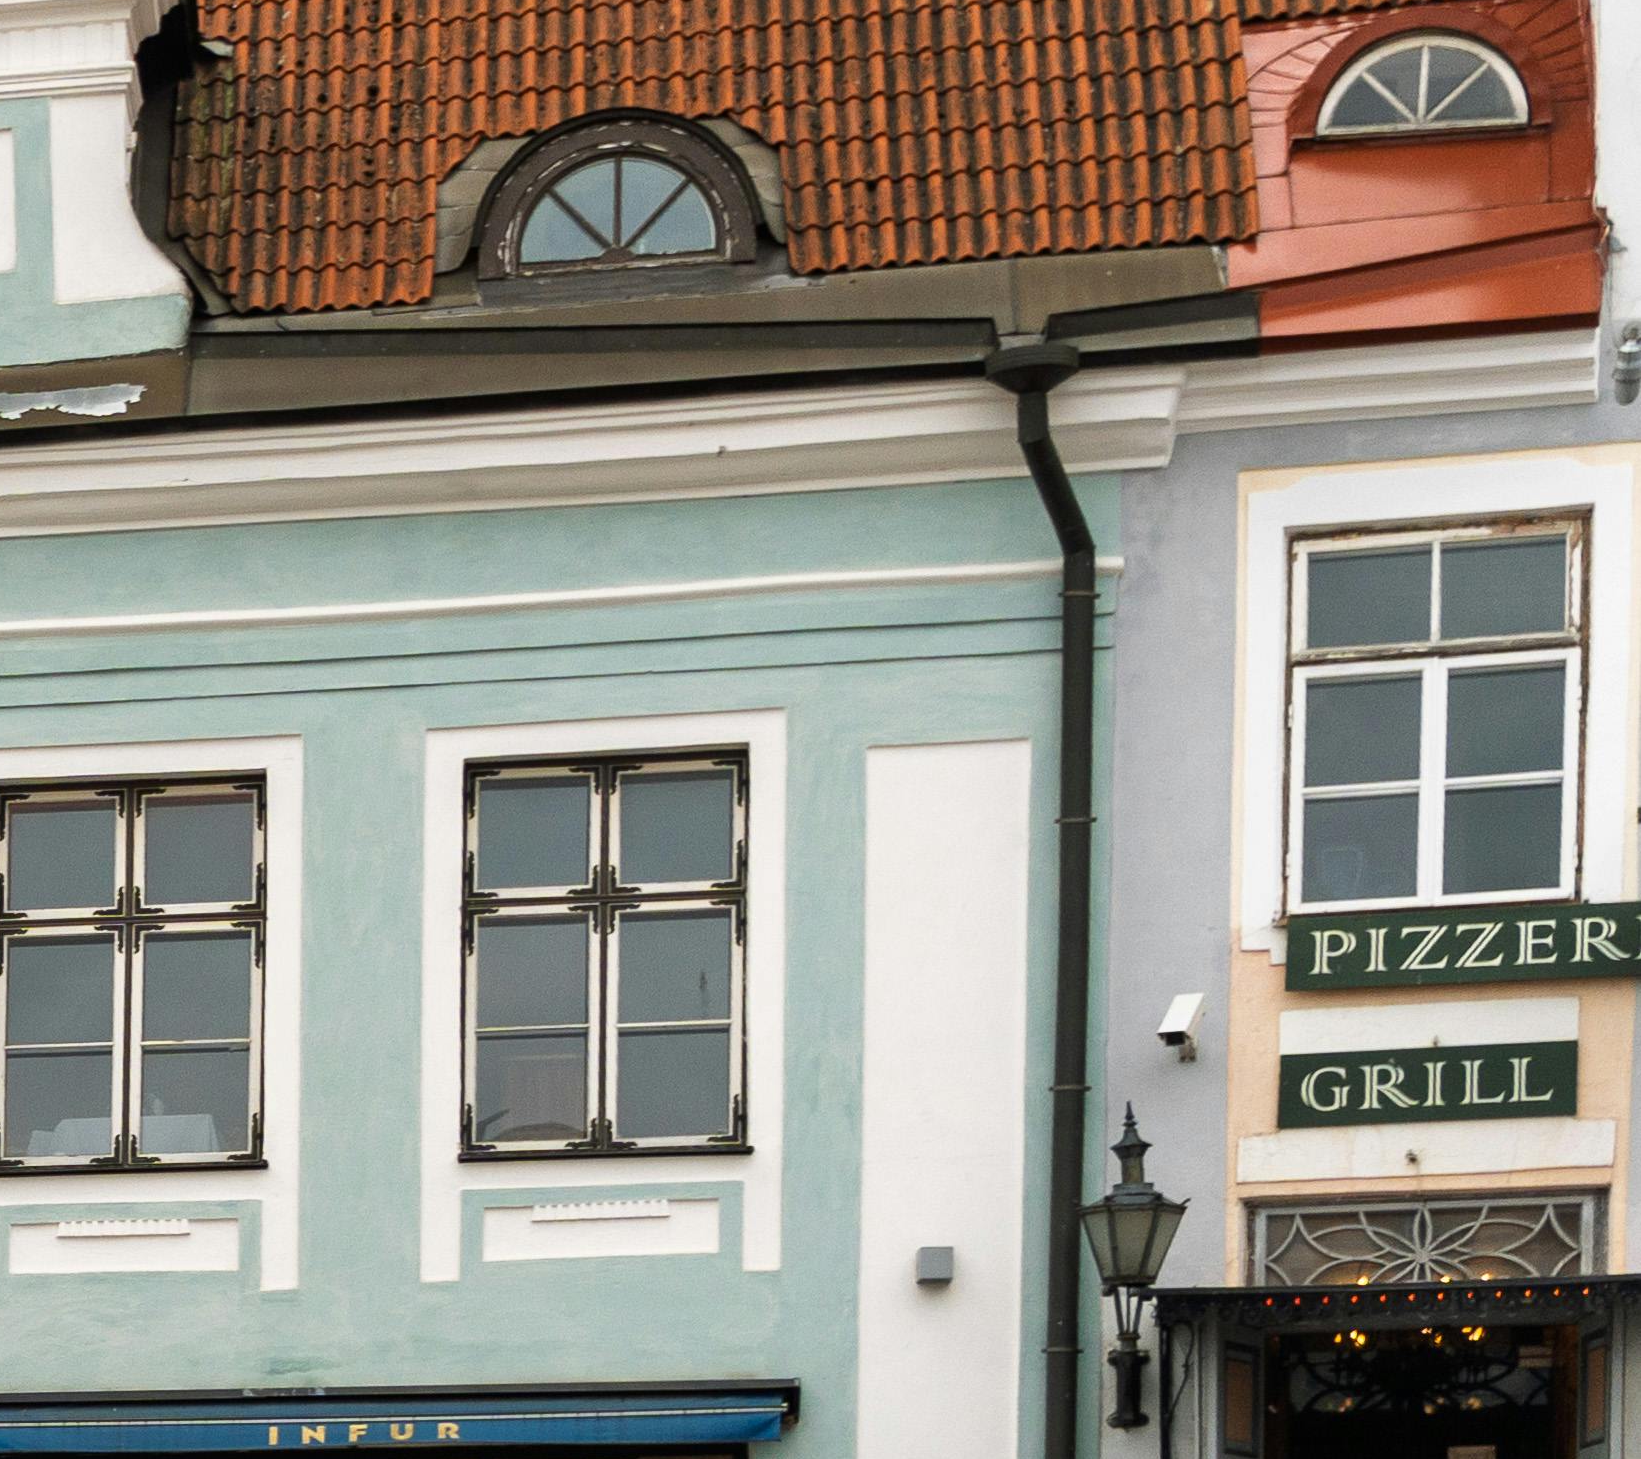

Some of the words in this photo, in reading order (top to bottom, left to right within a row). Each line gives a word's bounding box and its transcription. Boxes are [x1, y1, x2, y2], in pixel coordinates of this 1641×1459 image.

[1308, 915, 1641, 975] PIZZER
[1300, 1056, 1555, 1112] GRILL
[268, 1422, 461, 1446] INFUR
